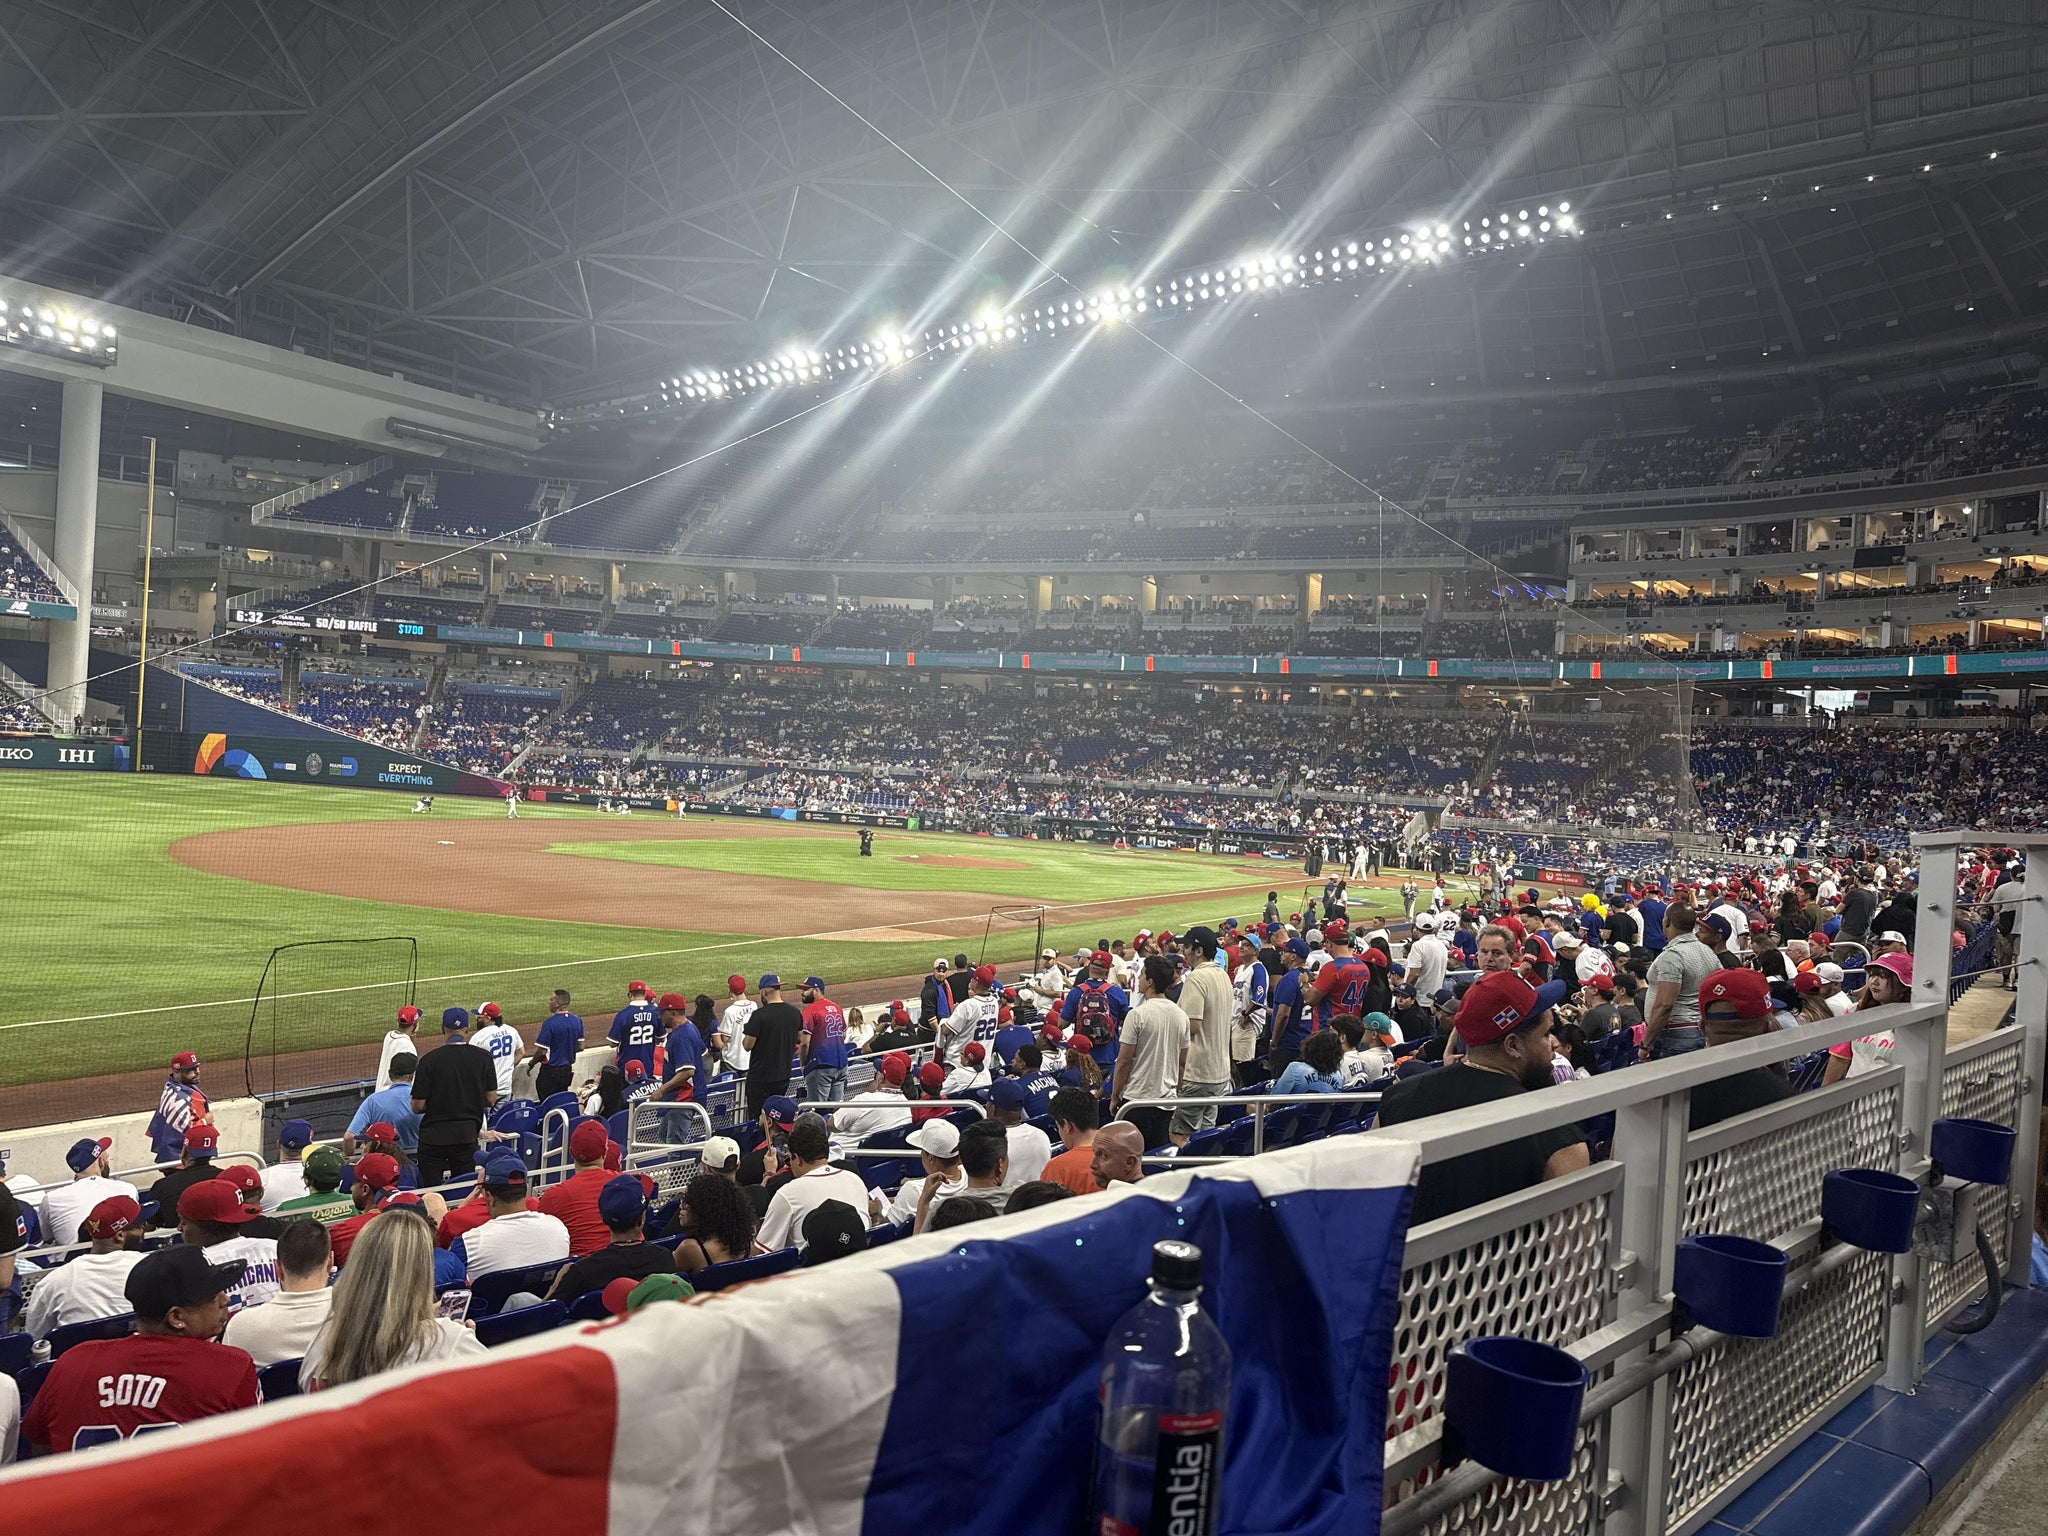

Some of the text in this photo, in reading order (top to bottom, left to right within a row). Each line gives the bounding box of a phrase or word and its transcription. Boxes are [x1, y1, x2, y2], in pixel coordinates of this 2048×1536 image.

[236, 610, 264, 623] 6:32
[272, 620, 311, 628] FOUNDATION
[316, 617, 378, 632] 50/50 RAFFLE
[398, 624, 424, 635] $1700
[58, 748, 96, 763] IHI
[388, 763, 422, 774] EXPECT
[378, 773, 433, 786] EVERYTHING
[1443, 920, 1459, 931] 22
[633, 1012, 652, 1022] SOTO
[981, 1004, 996, 1016] SOTO
[825, 1014, 844, 1037] 22
[973, 1018, 997, 1041] 22
[629, 1025, 654, 1045] 22
[489, 1035, 512, 1059] 28
[1304, 1073, 1340, 1089] MEADOWS
[312, 1204, 352, 1219] Trojans
[98, 1374, 167, 1409] SOTO
